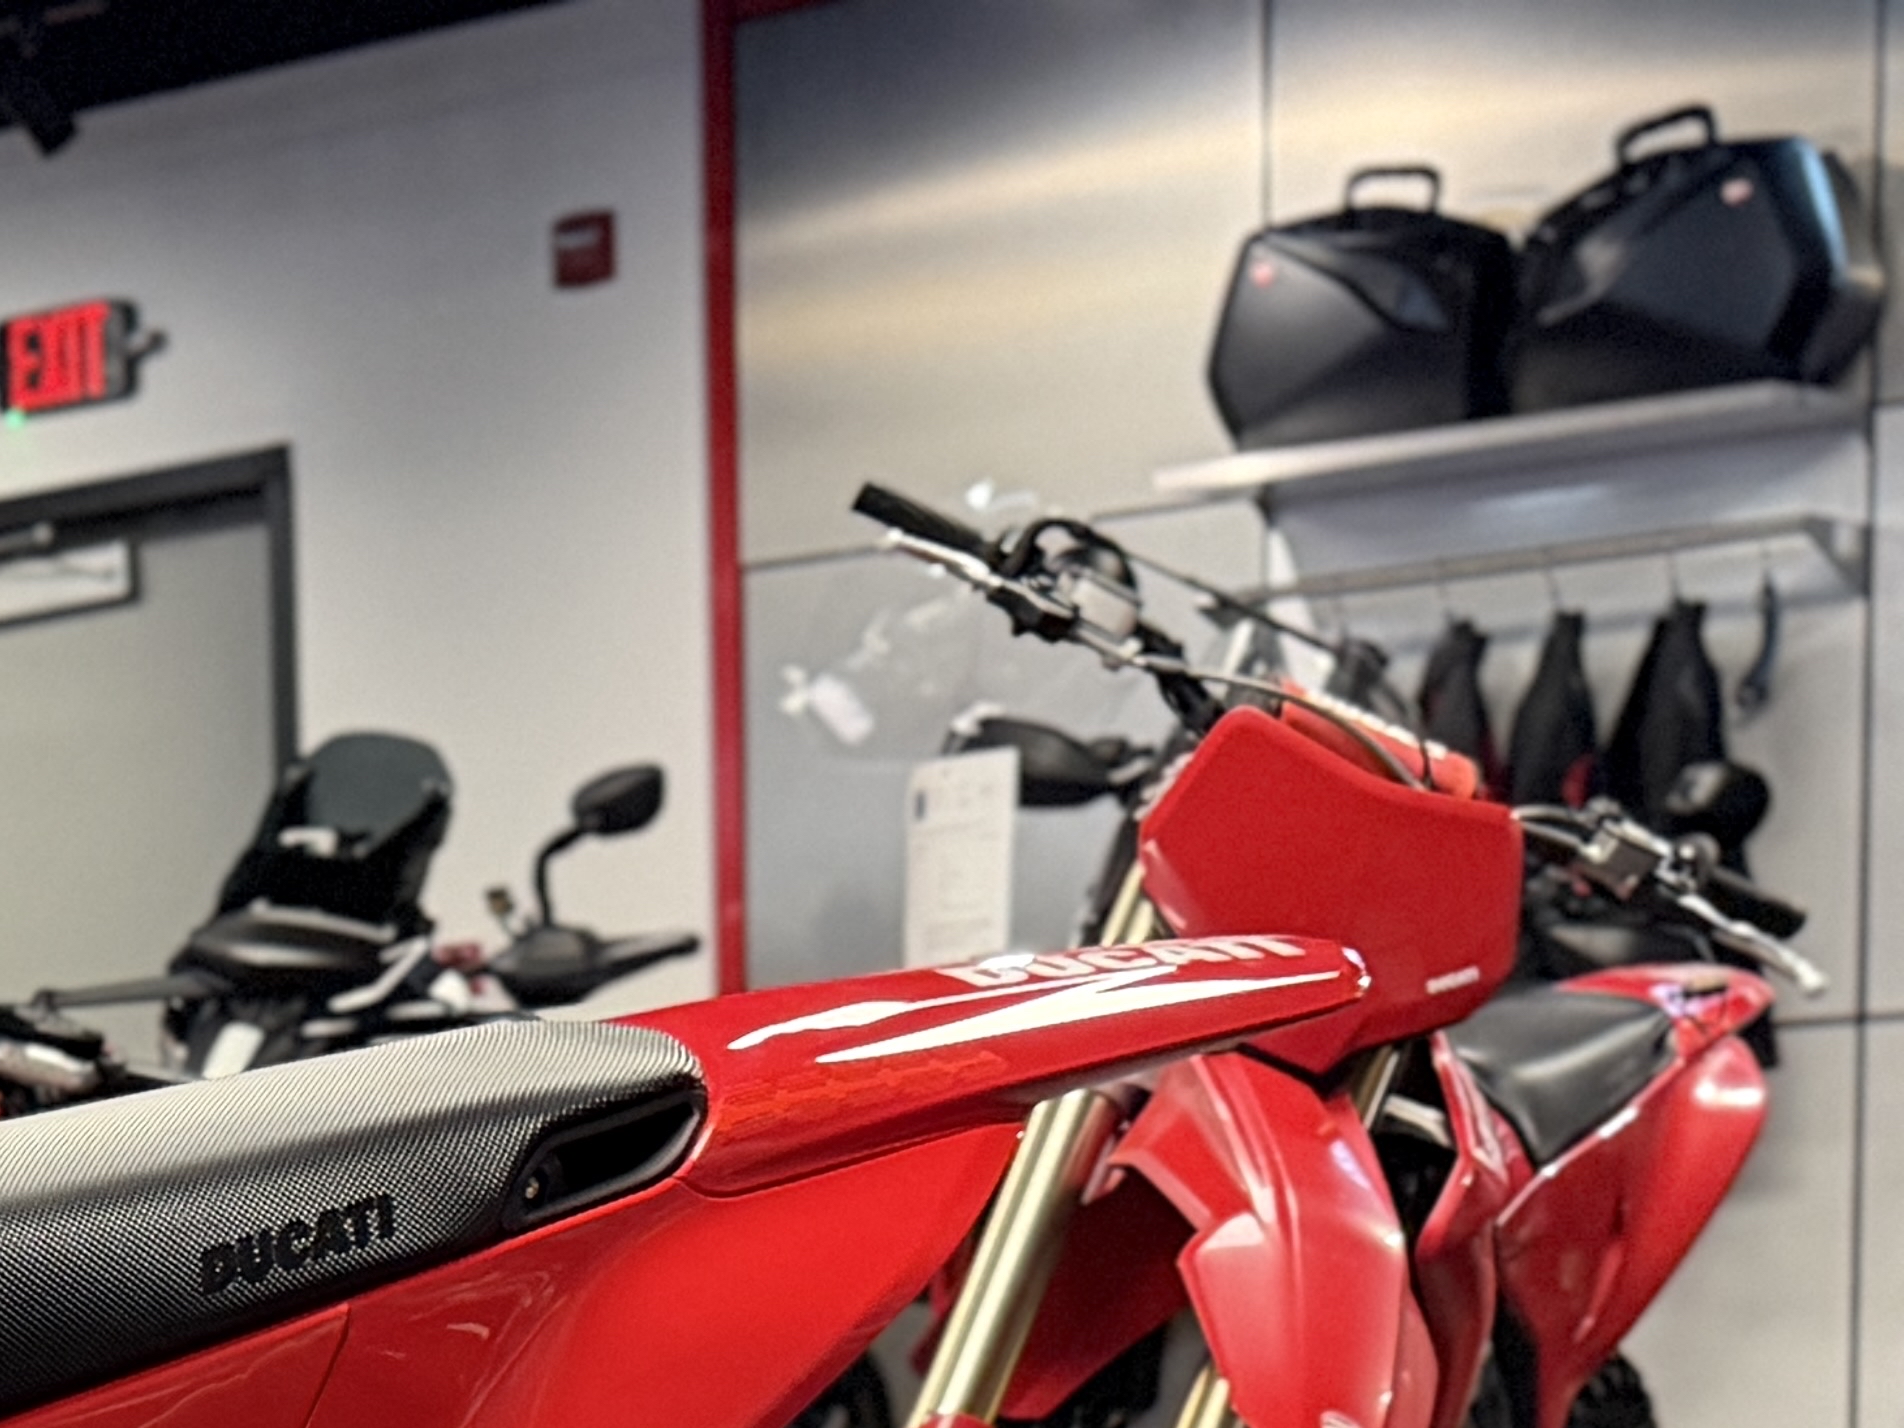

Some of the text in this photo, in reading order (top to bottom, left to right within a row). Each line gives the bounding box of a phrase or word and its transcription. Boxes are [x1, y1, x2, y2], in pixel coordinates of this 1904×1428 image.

[7, 299, 111, 412] EXIT
[938, 934, 1305, 987] DUCATI
[200, 1194, 396, 1295] DUCATI
